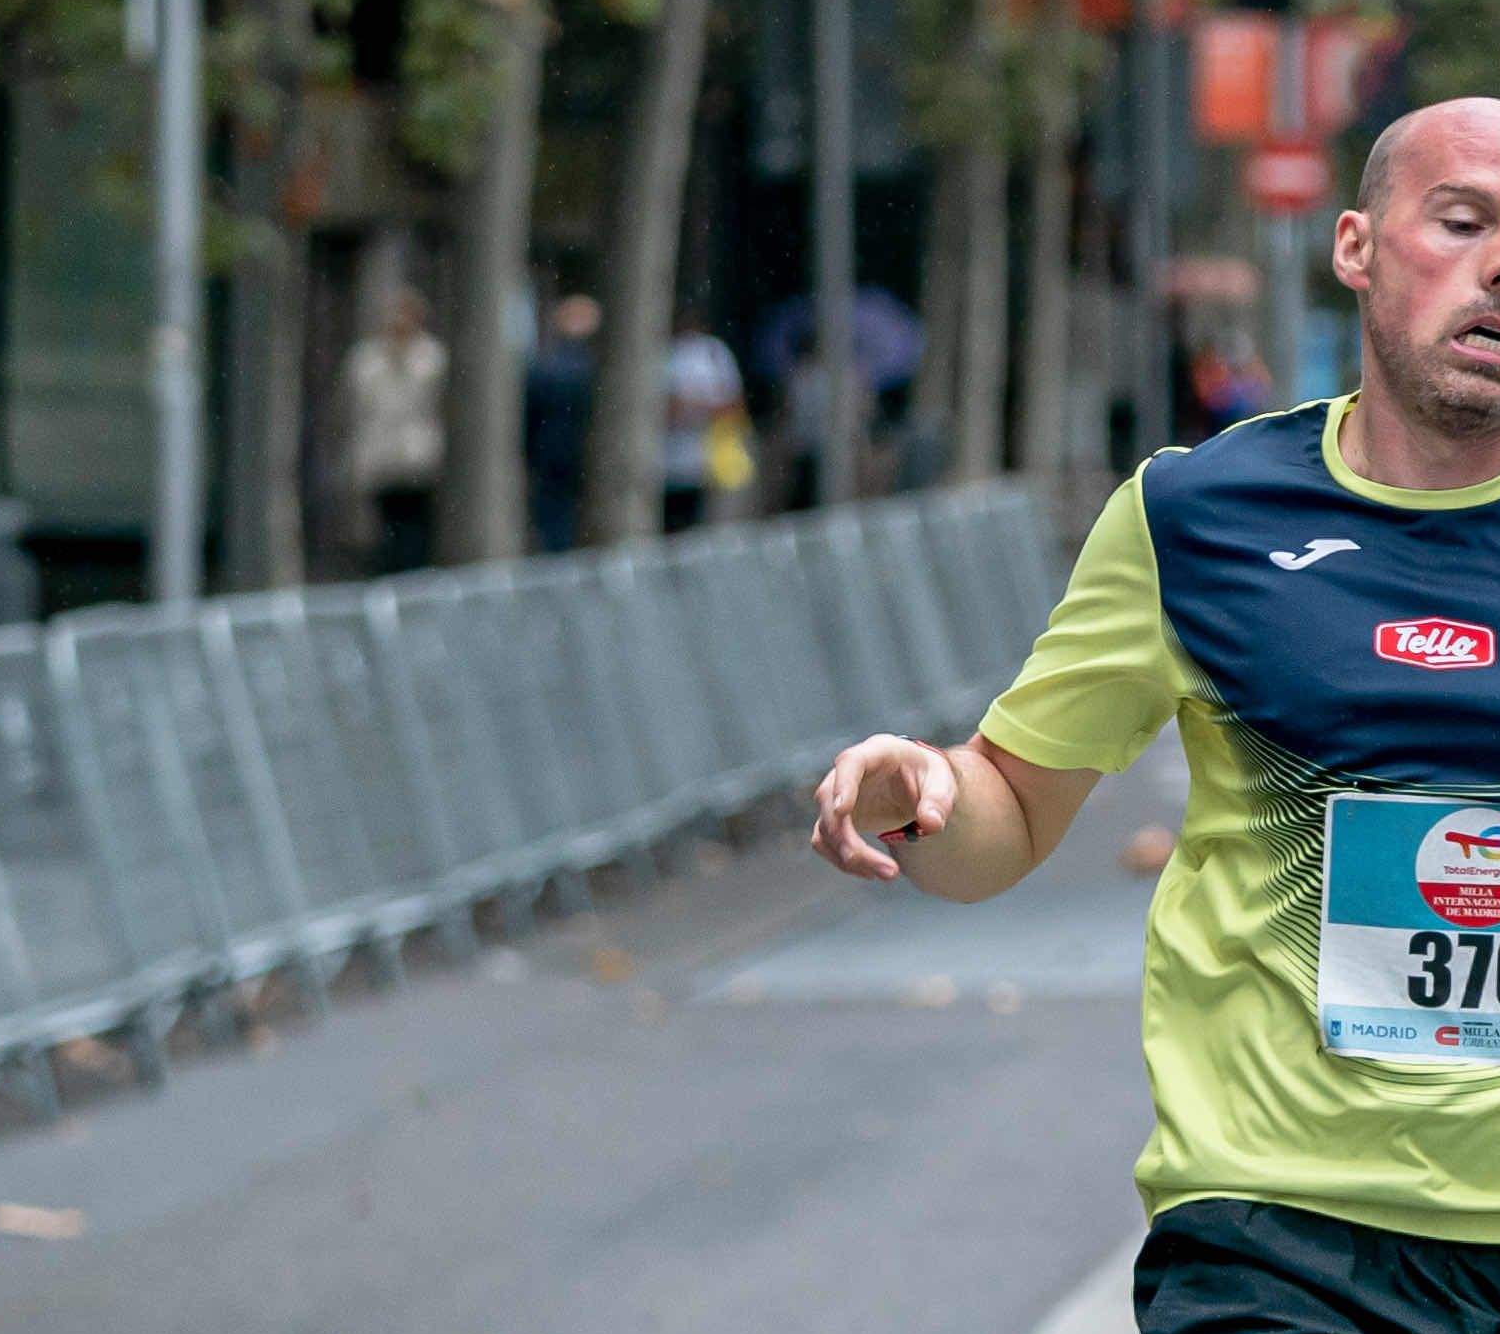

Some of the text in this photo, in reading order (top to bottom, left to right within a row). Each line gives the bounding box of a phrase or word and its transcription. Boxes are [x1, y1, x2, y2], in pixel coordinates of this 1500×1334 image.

[1395, 626, 1478, 663] Tello
[1459, 886, 1494, 897] MILLA
[1445, 907, 1461, 917] DE
[1351, 1023, 1418, 1041] MADRID
[1462, 1026, 1500, 1038] MILLA
